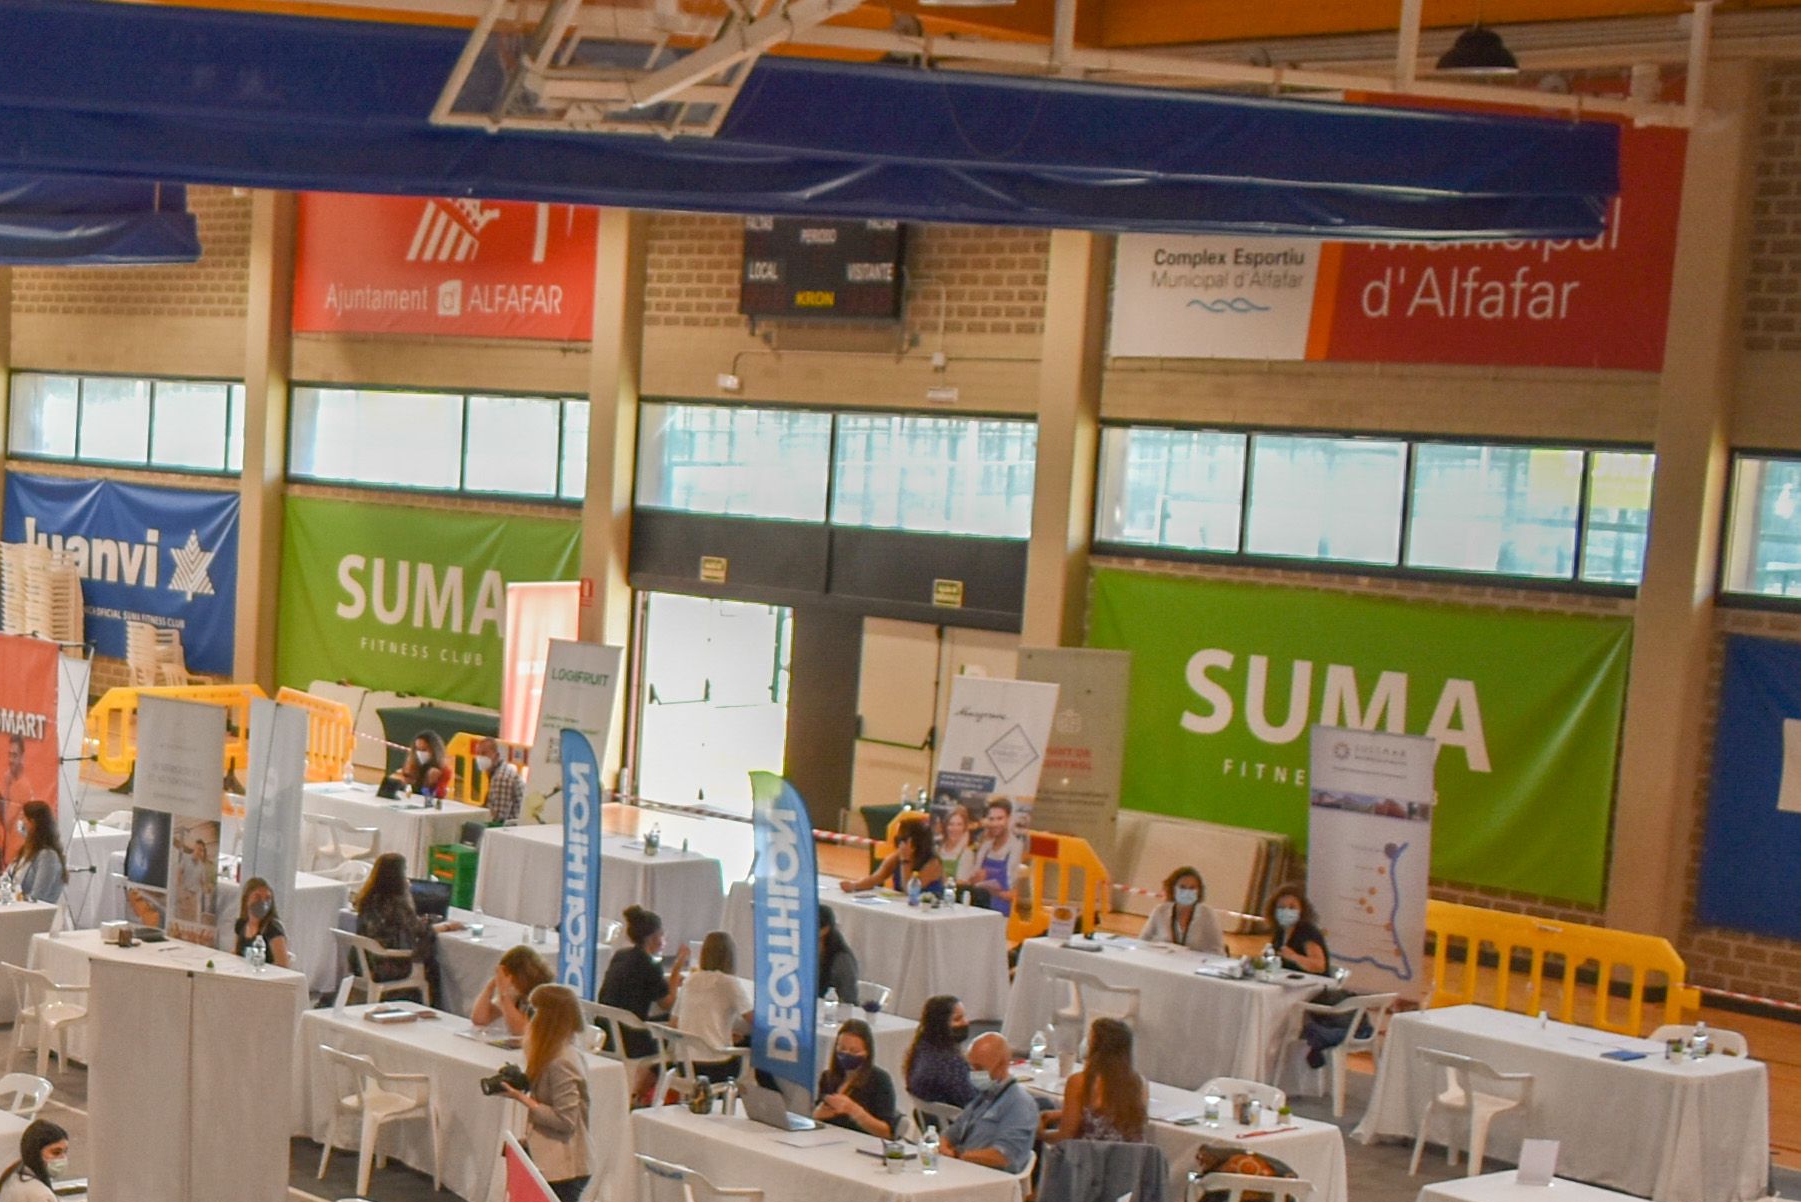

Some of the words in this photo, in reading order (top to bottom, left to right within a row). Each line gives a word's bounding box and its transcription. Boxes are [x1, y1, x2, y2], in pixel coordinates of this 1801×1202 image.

[748, 261, 779, 281] LOCAL
[846, 262, 894, 282] VISITANTE
[1153, 248, 1227, 268] Complex
[1232, 247, 1305, 267] Esportiu
[1151, 270, 1229, 290] Municipal
[1233, 270, 1304, 289] d'Alfafar
[1361, 265, 1581, 319] d'Alfafar
[324, 283, 428, 317] Ajuntament
[468, 284, 564, 314] ALFAFAR
[336, 554, 506, 637] SUMA
[360, 636, 430, 660] FITNESS
[440, 647, 484, 667] CLUB
[551, 667, 609, 687] LOGIFRUIT
[1179, 648, 1492, 773] SUMA
[1222, 758, 1306, 787] FITNE
